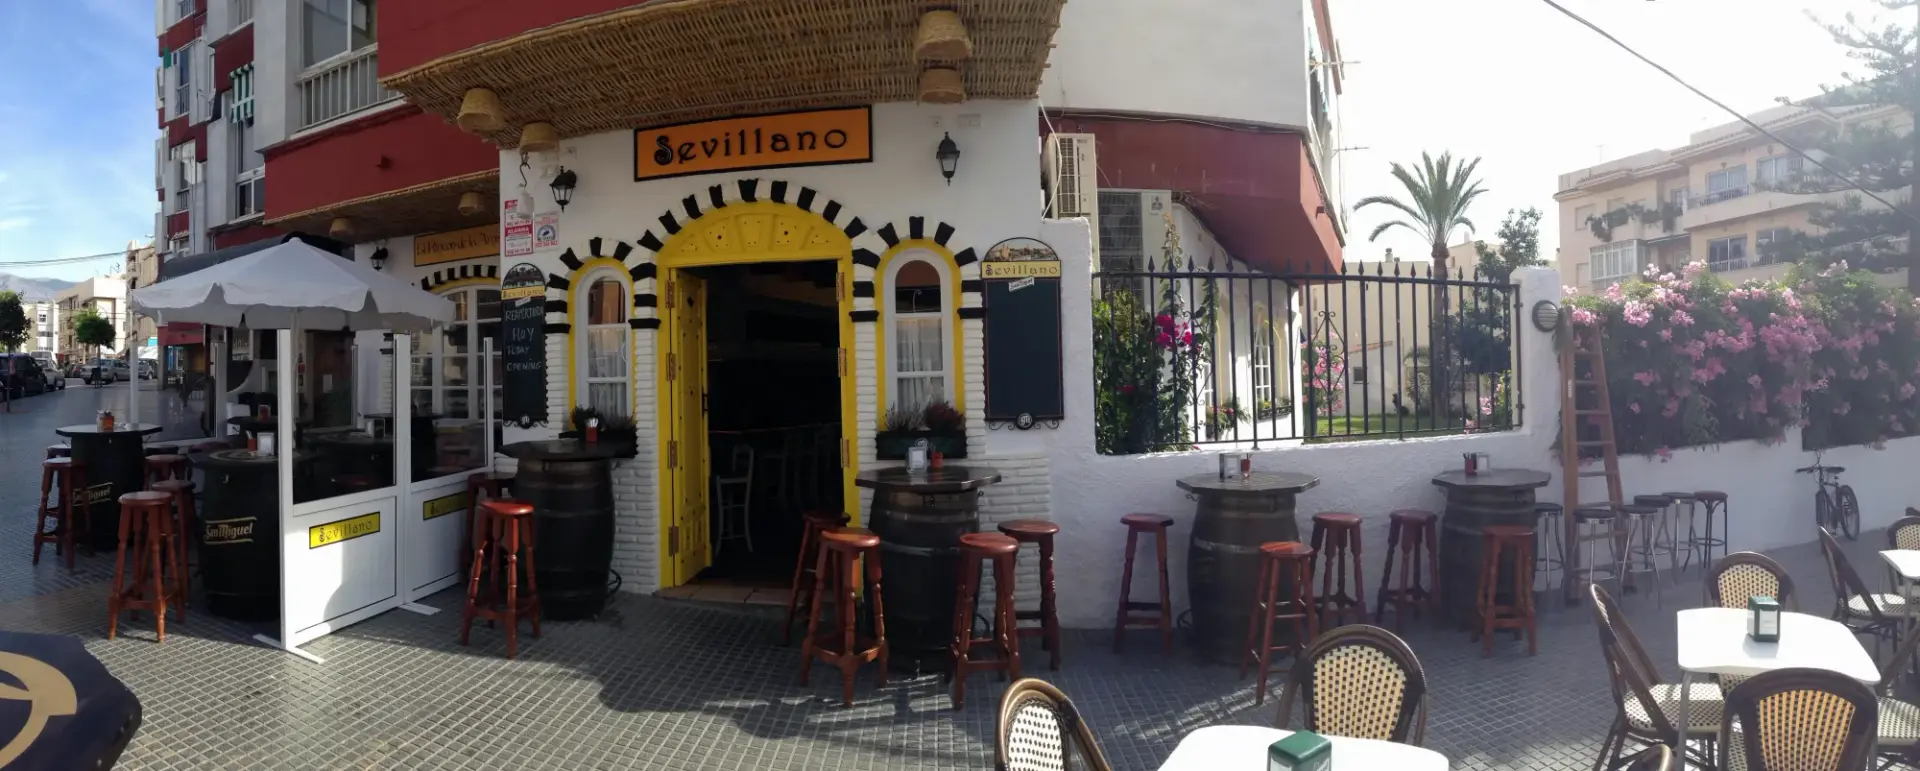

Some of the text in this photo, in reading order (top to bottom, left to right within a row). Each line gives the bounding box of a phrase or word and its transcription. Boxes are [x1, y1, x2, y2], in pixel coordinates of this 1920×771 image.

[654, 129, 847, 165] Sevillano
[984, 264, 1058, 276] Sevillano
[319, 519, 373, 543] Sevillano
